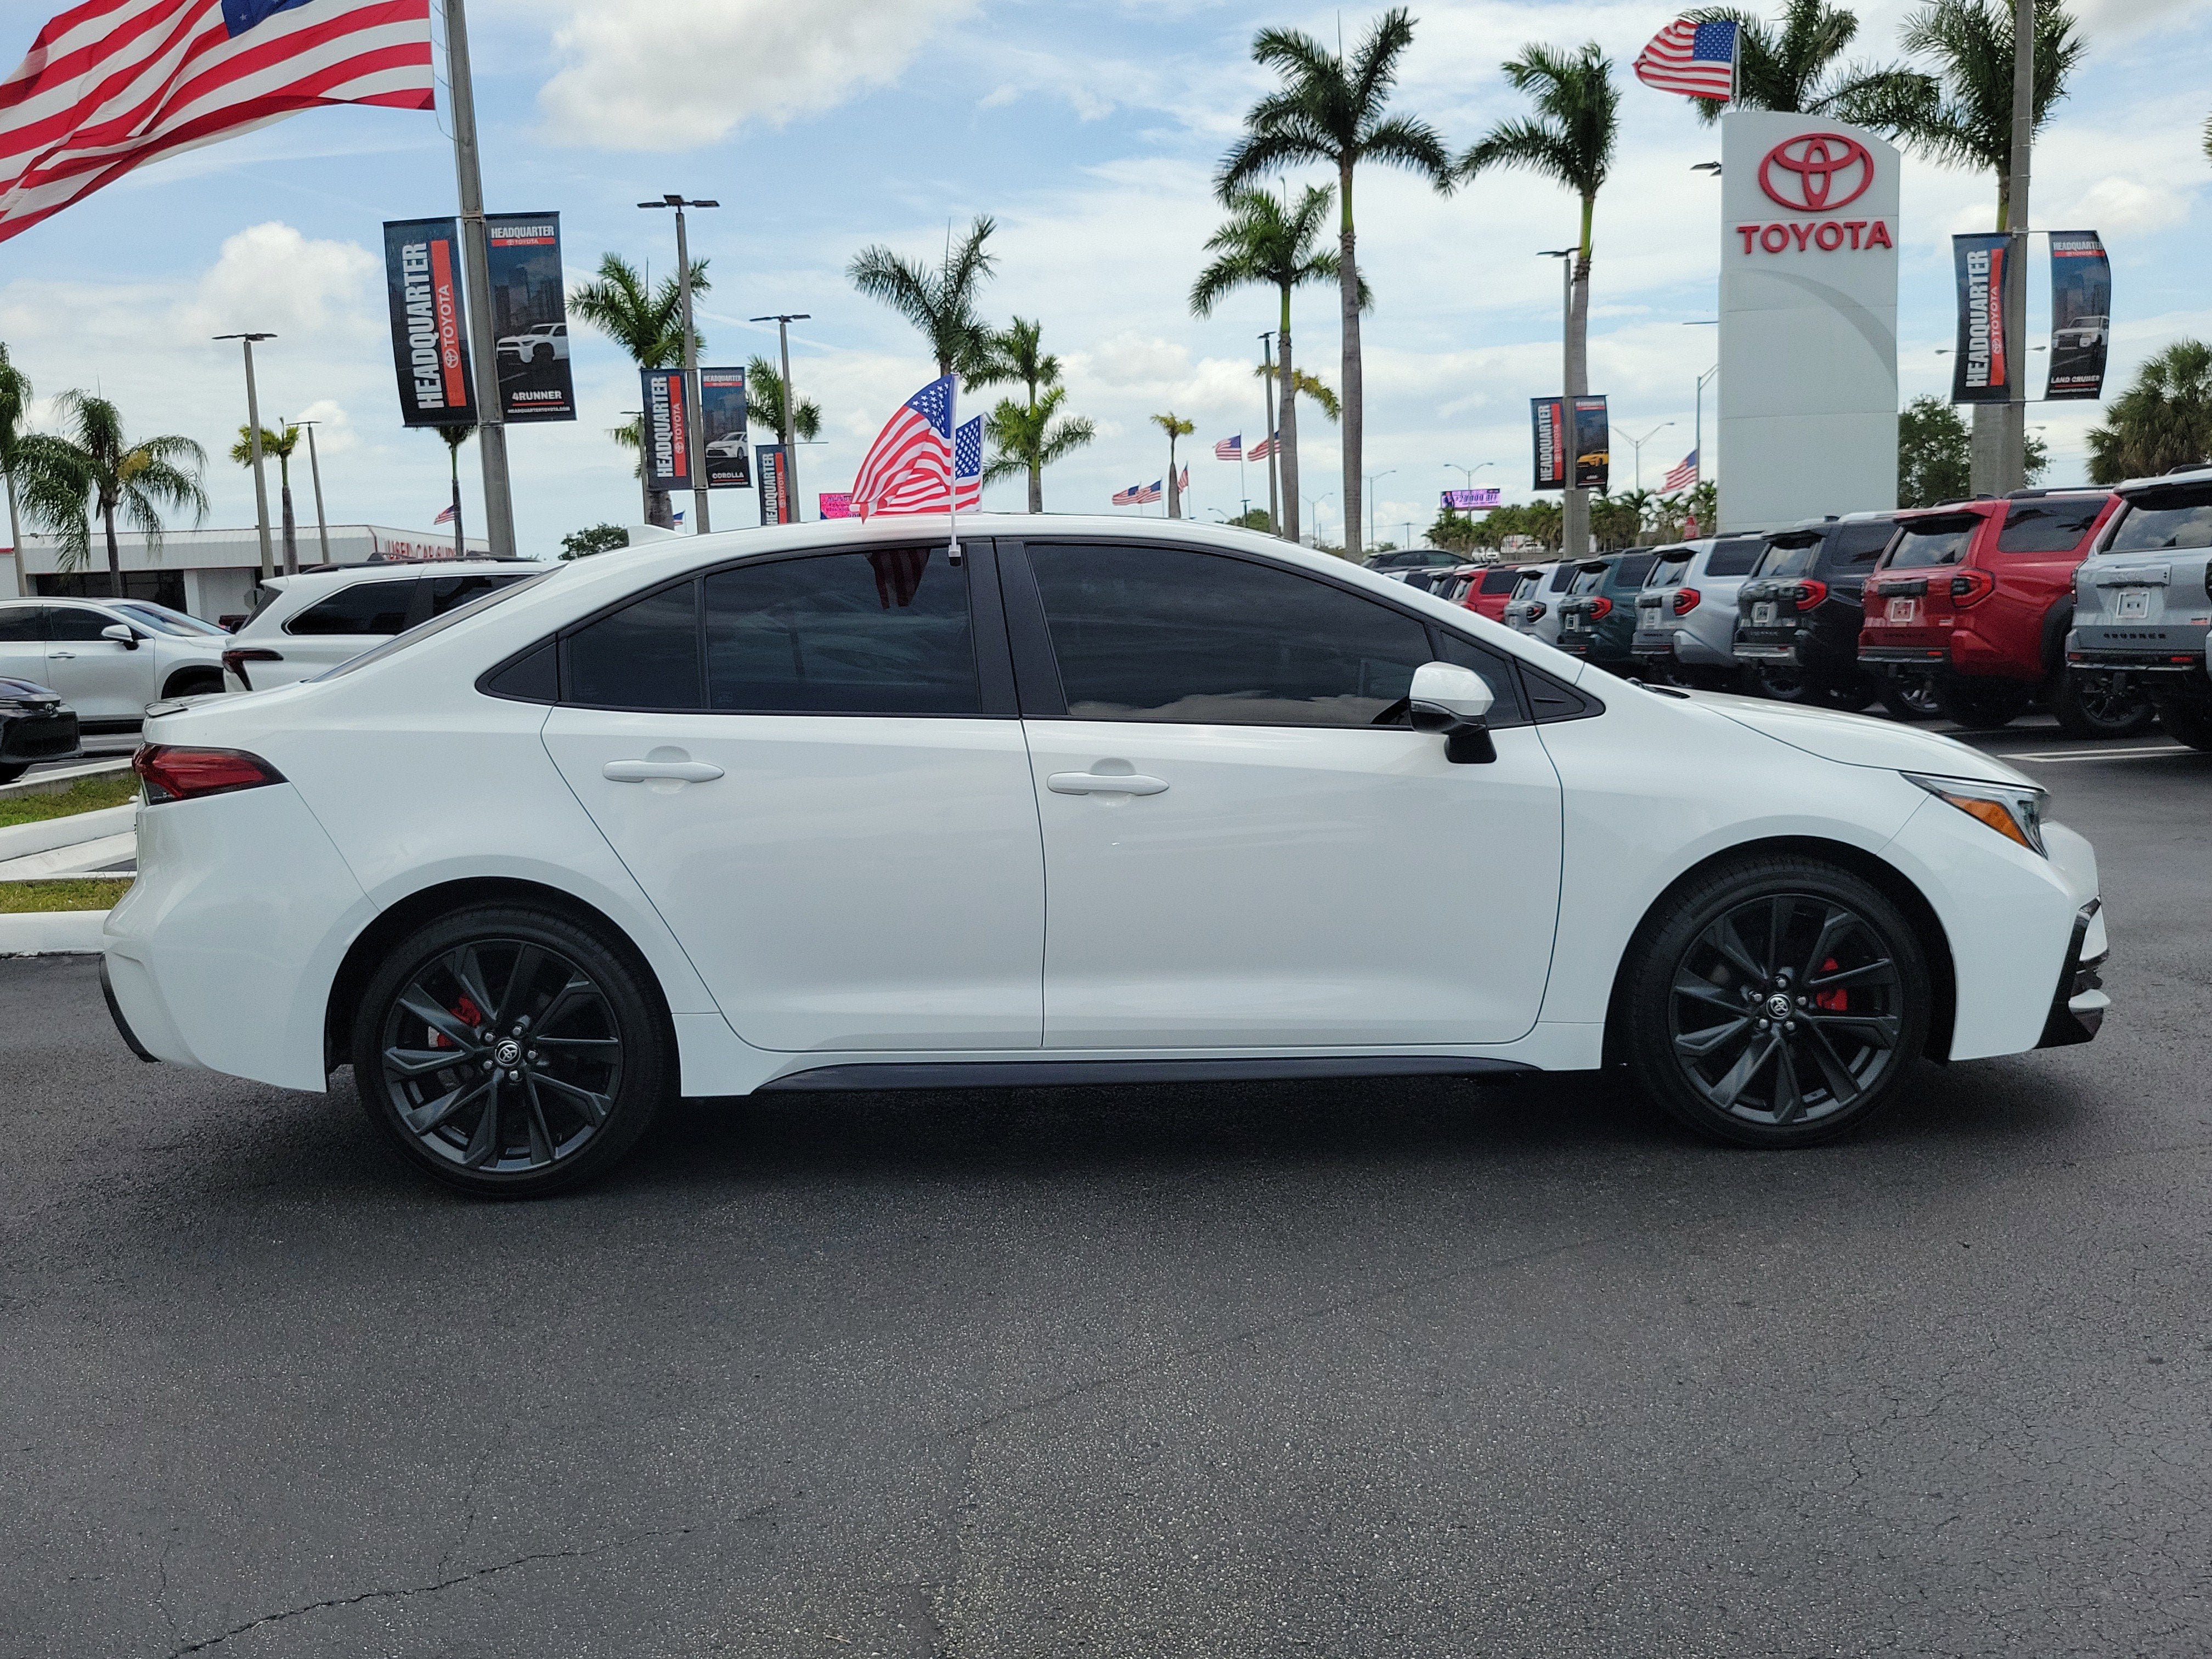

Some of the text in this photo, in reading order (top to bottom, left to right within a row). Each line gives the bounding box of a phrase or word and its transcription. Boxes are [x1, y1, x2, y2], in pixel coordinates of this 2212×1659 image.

[492, 225, 555, 239] HEADQUARTER
[1737, 221, 1893, 255] TOYOTA
[402, 242, 445, 409] HEADQUARTER
[438, 284, 455, 347] TOYOTA
[1966, 250, 1991, 387] HEADQUARTER
[1990, 286, 2002, 337] TOYOTA
[511, 390, 562, 401] 4RUNNER
[651, 376, 674, 477] HEADQUARTER
[673, 403, 683, 441] TOYOTA
[1538, 405, 1554, 482] HEADQUARTER
[763, 453, 778, 526] HEADQUARTER
